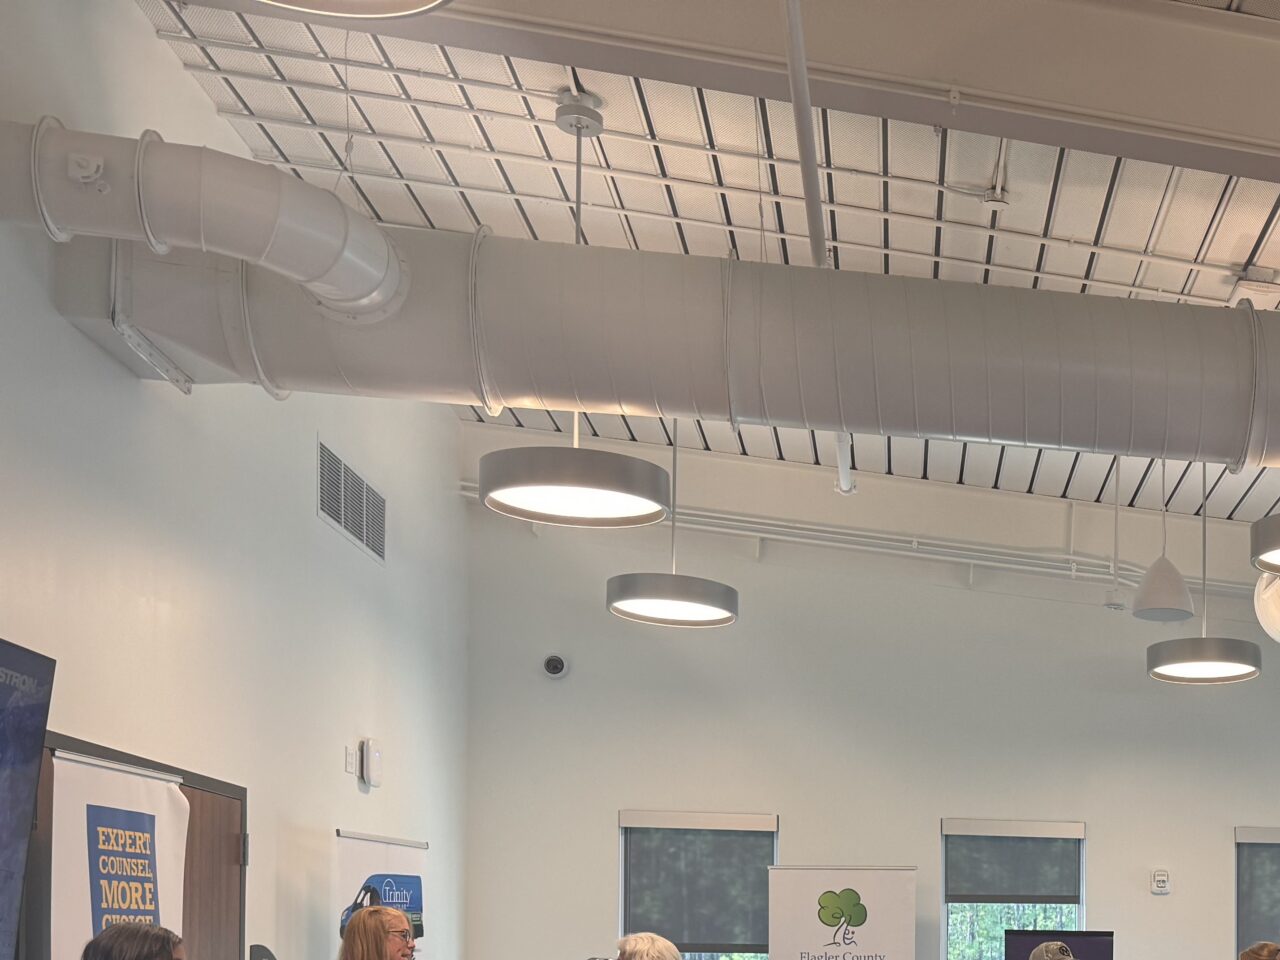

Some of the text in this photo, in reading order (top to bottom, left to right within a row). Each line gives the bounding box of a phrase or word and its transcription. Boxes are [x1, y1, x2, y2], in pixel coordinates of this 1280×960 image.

[97, 826, 151, 854] EXPERT
[99, 855, 153, 881] COUNSEL,
[100, 879, 155, 910] MORE
[383, 886, 411, 905] Trinity
